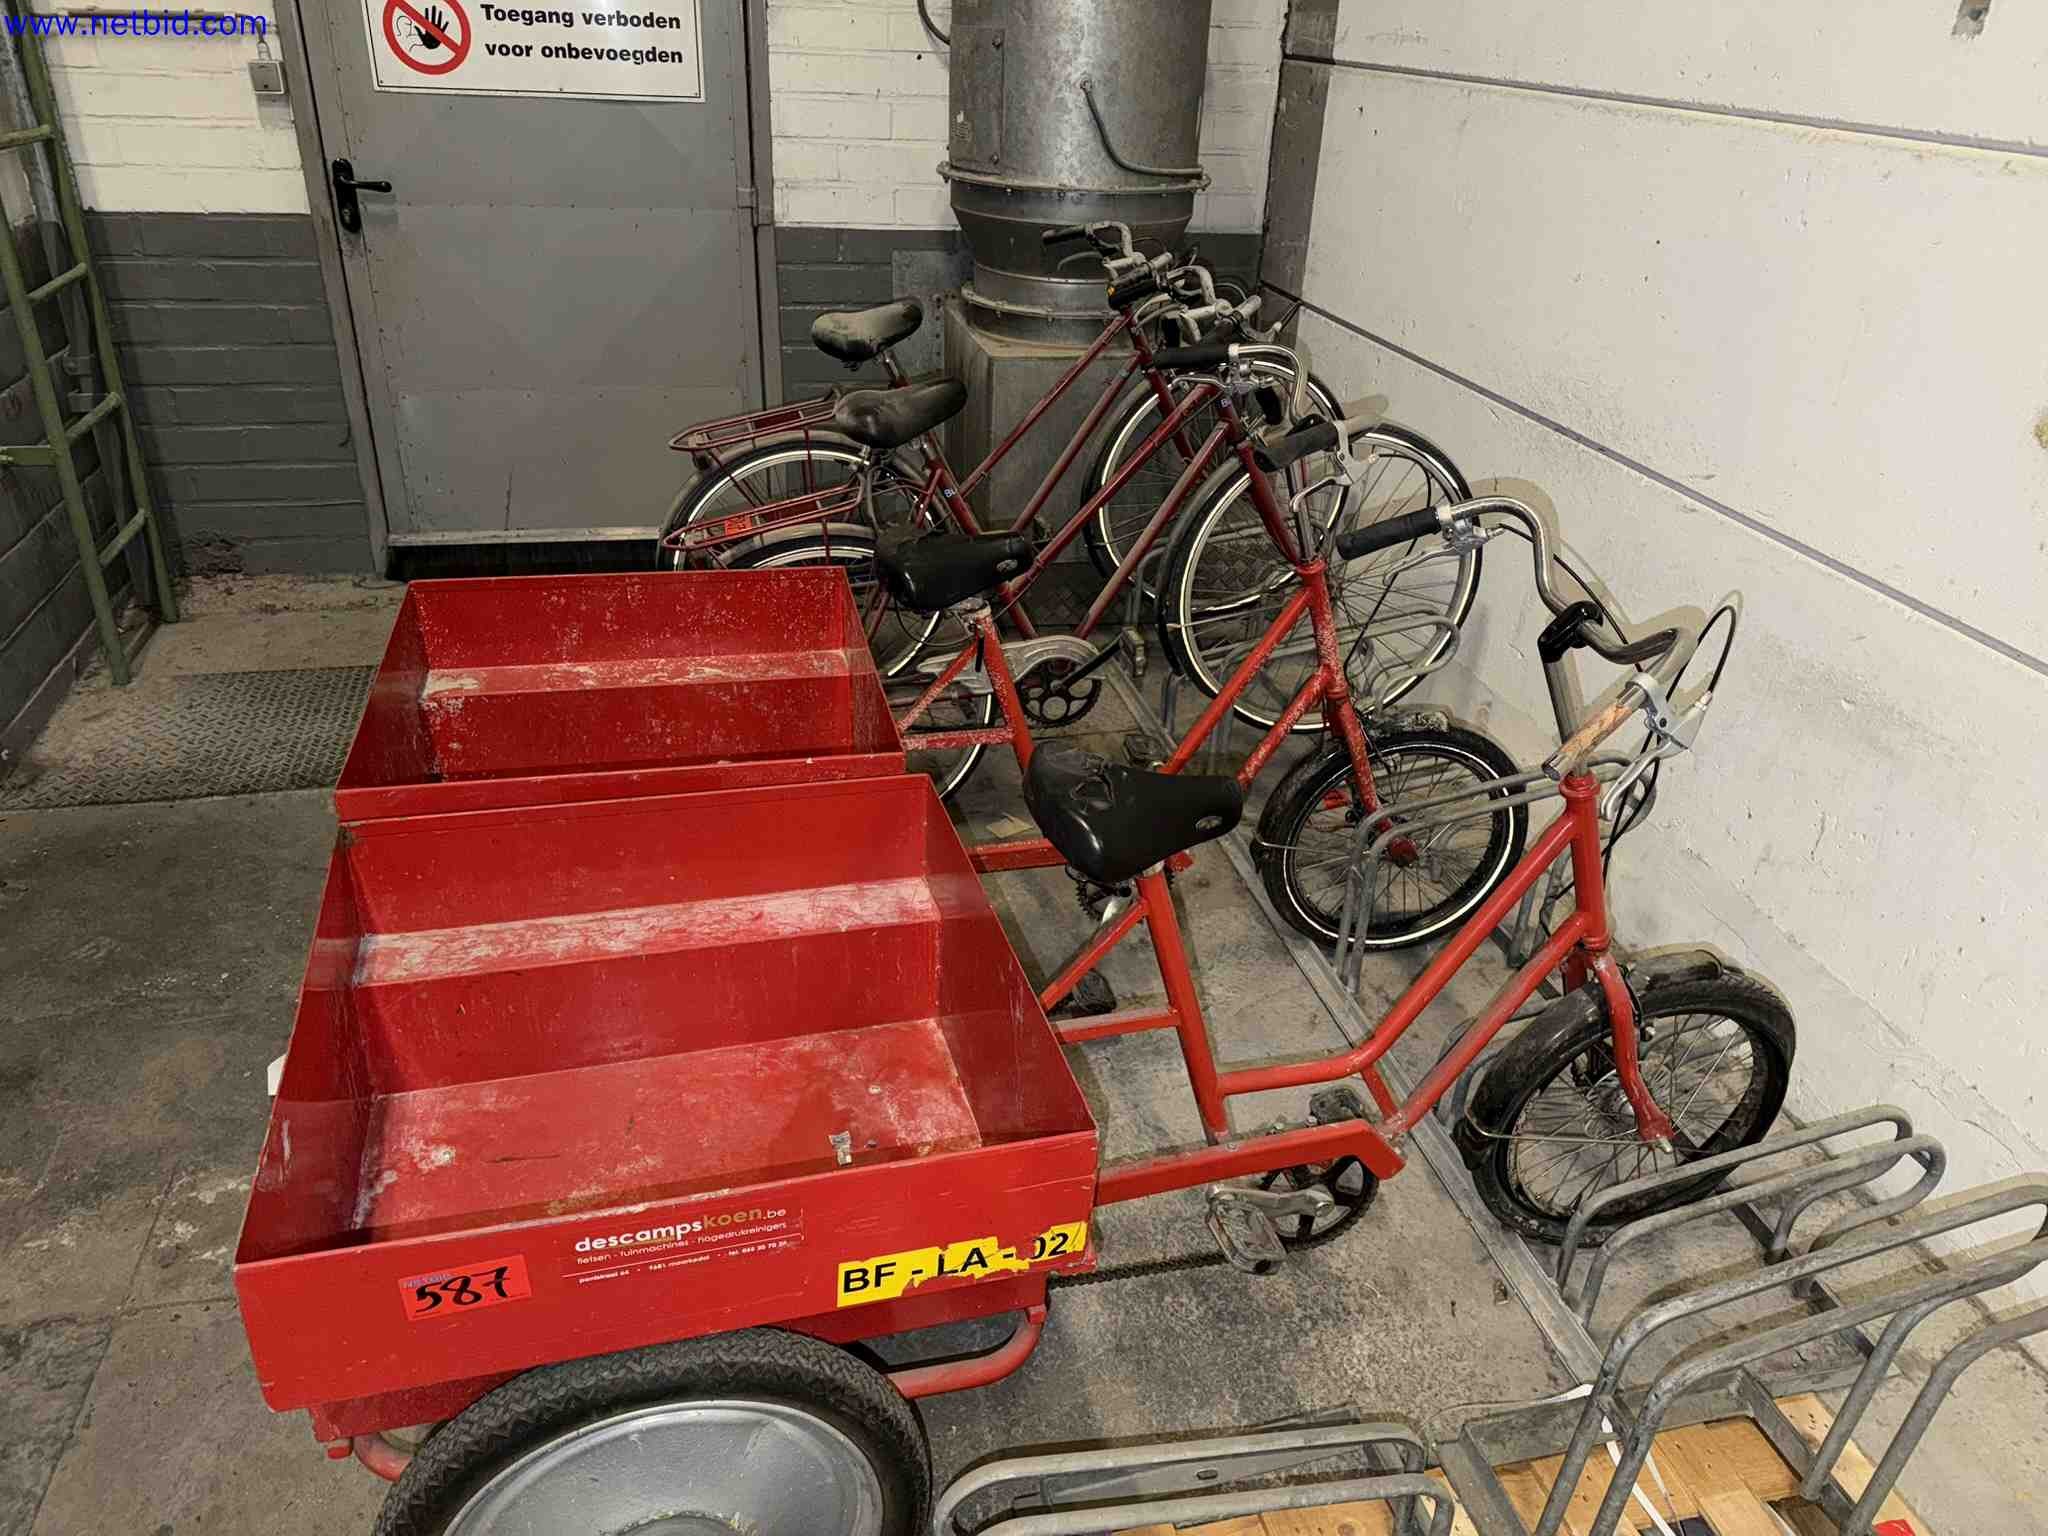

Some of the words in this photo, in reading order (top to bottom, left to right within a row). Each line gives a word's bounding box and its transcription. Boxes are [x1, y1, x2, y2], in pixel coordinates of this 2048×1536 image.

[480, 4, 575, 28] Toegang
[582, 10, 682, 30] verboden
[485, 43, 534, 57] voor
[541, 43, 684, 65] onbevoegden
[574, 1208, 787, 1253] descampskoen.be
[415, 1265, 512, 1313] 587
[842, 1261, 897, 1294] BF
[937, 1247, 989, 1277] LA
